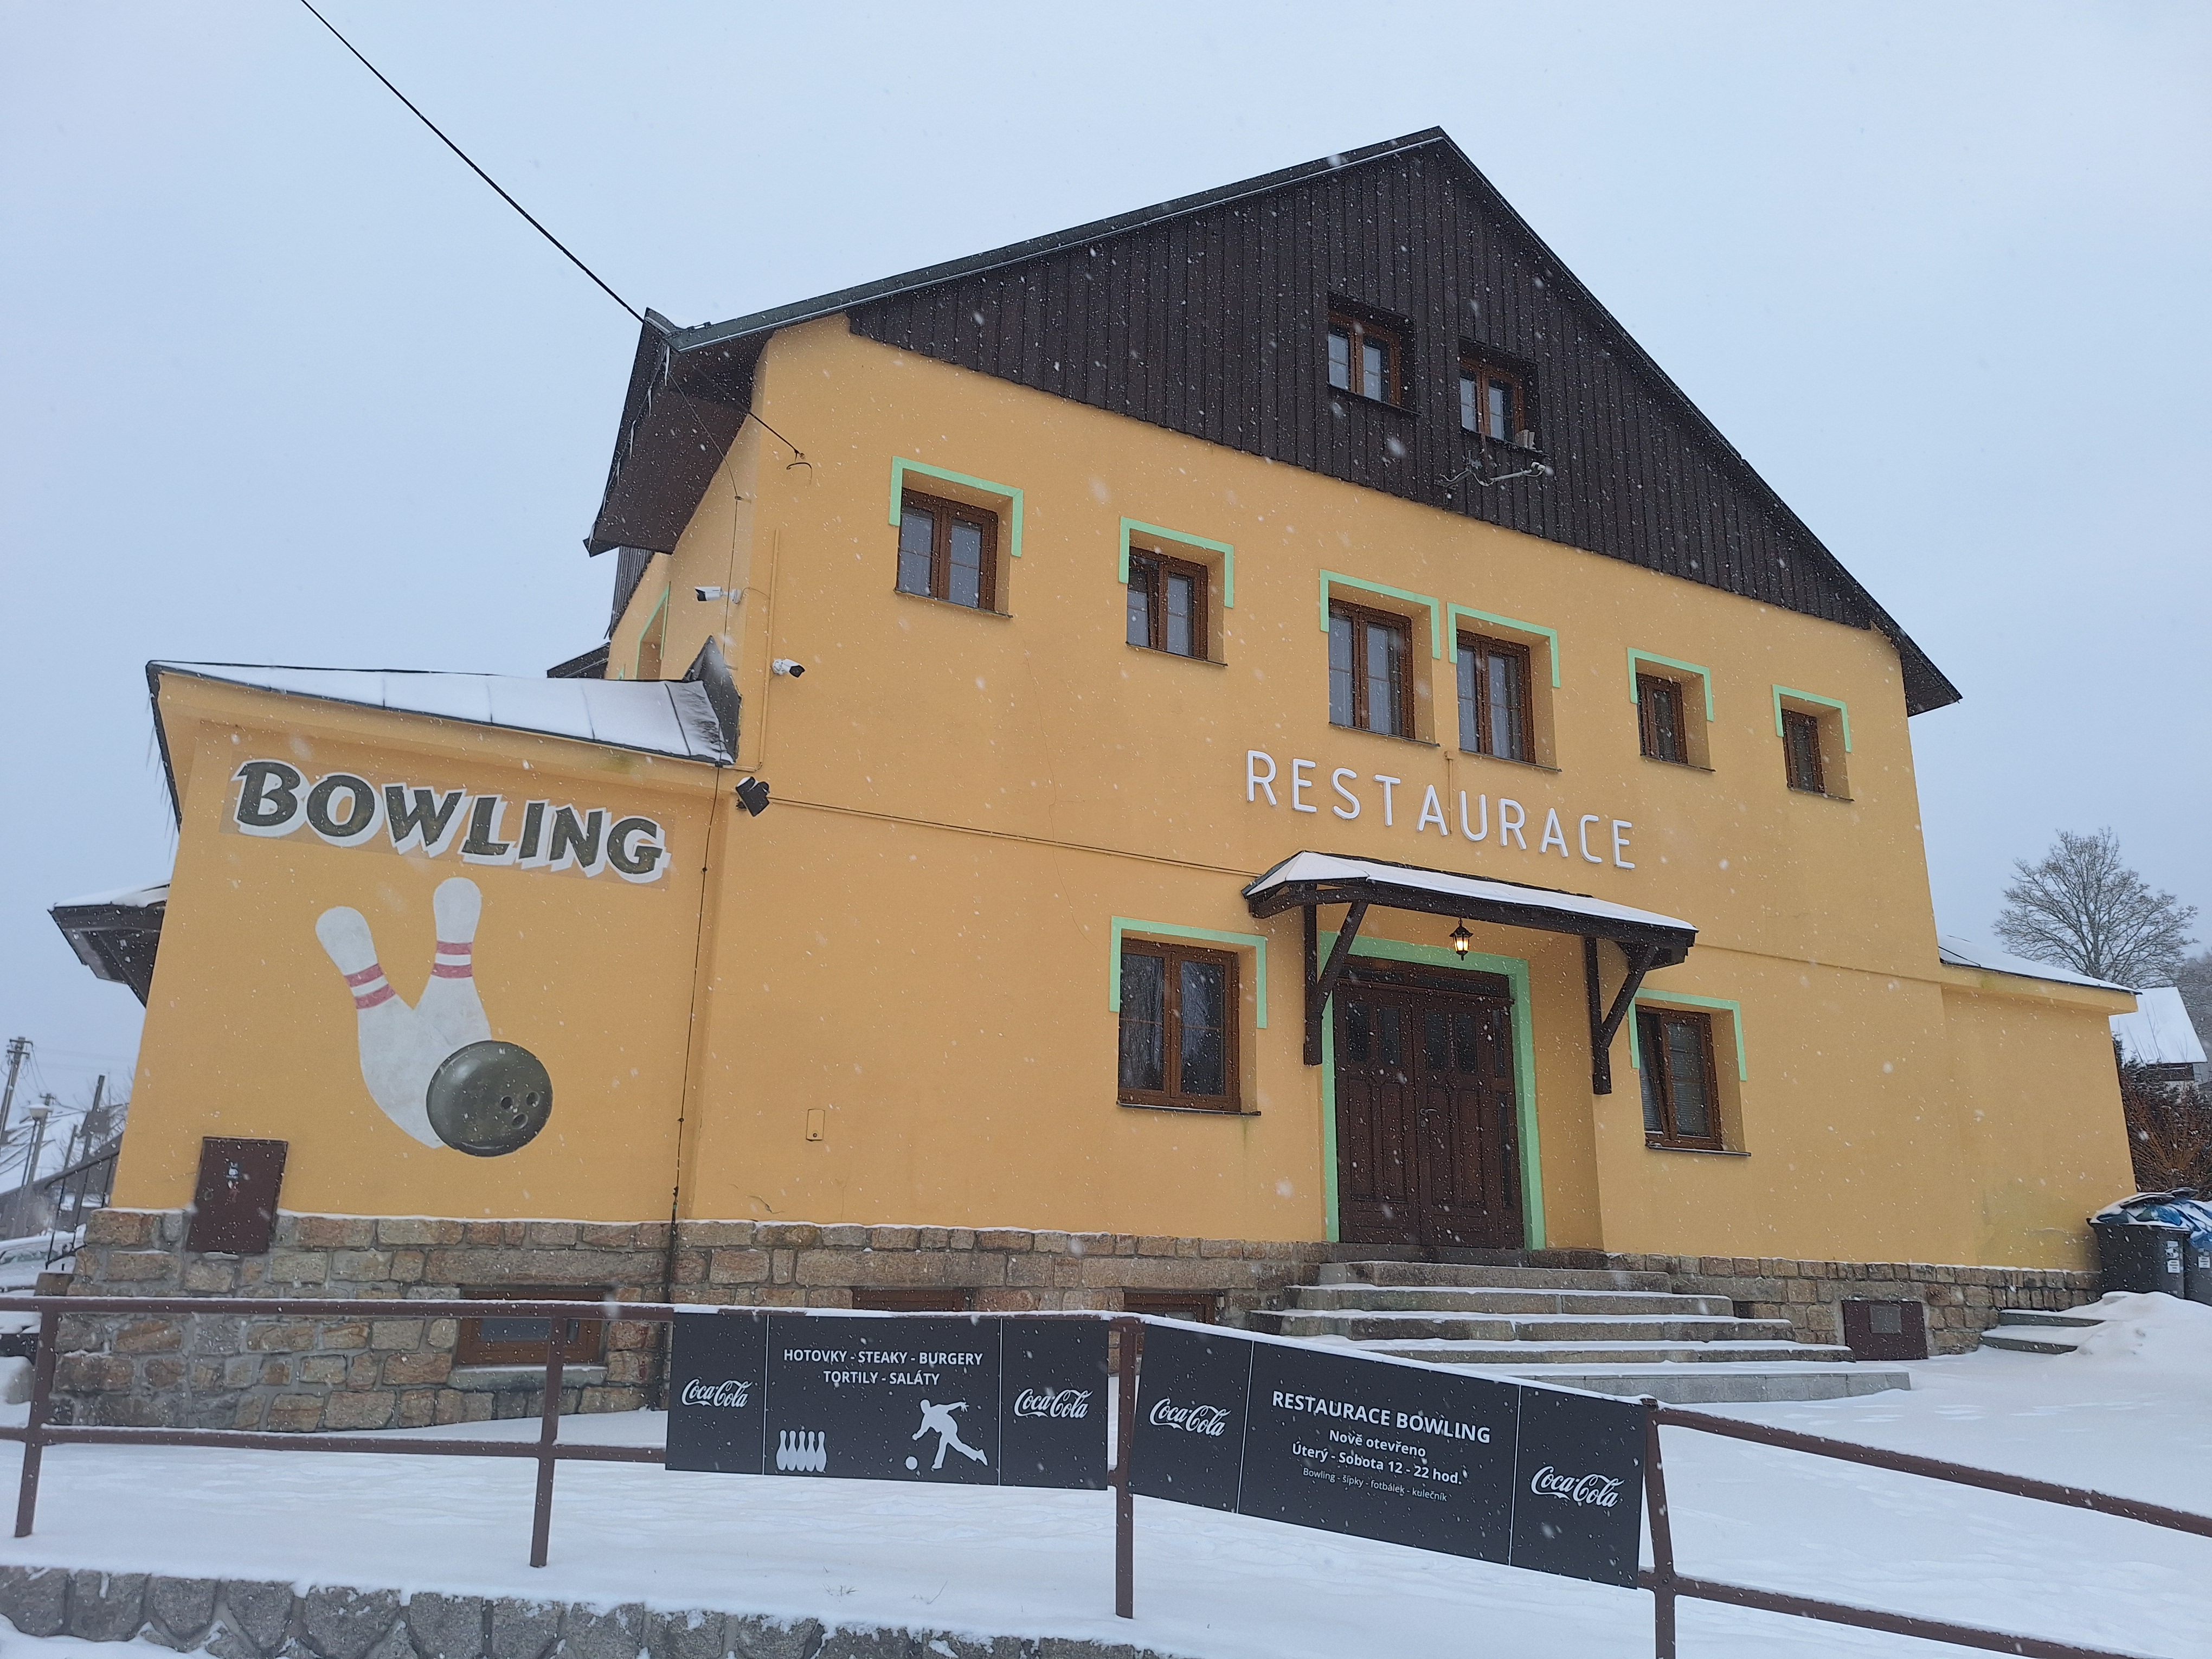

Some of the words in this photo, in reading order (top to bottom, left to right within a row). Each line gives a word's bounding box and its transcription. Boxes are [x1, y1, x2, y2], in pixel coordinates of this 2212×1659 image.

[231, 759, 672, 884] BOWLING
[1246, 750, 1635, 869] RESTAURACE
[783, 1349, 847, 1363] HOTOVKY
[858, 1351, 908, 1364] STEAKY
[919, 1352, 983, 1366] BURGERY
[681, 1379, 753, 1407] Coca-Cola
[823, 1371, 878, 1384] TORTILY
[889, 1369, 940, 1386] SALÁTY
[1014, 1388, 1094, 1418] Coca-Cola
[1150, 1398, 1232, 1436] Coca-Cola
[1272, 1390, 1391, 1426] RESTAURACE
[1397, 1412, 1491, 1443] BOWLING
[1329, 1429, 1363, 1446] Nově
[1366, 1440, 1426, 1457] otevřeno
[1292, 1441, 1328, 1463] Úterý
[1339, 1452, 1384, 1470] Sobota
[1388, 1461, 1403, 1474] 12
[1413, 1465, 1429, 1479] 22
[1432, 1468, 1462, 1484] hod.
[1303, 1468, 1335, 1483] Bowling
[1371, 1480, 1405, 1494] fotbálek
[1412, 1487, 1448, 1501] kulečník
[1531, 1466, 1625, 1507] Coca-Cola
